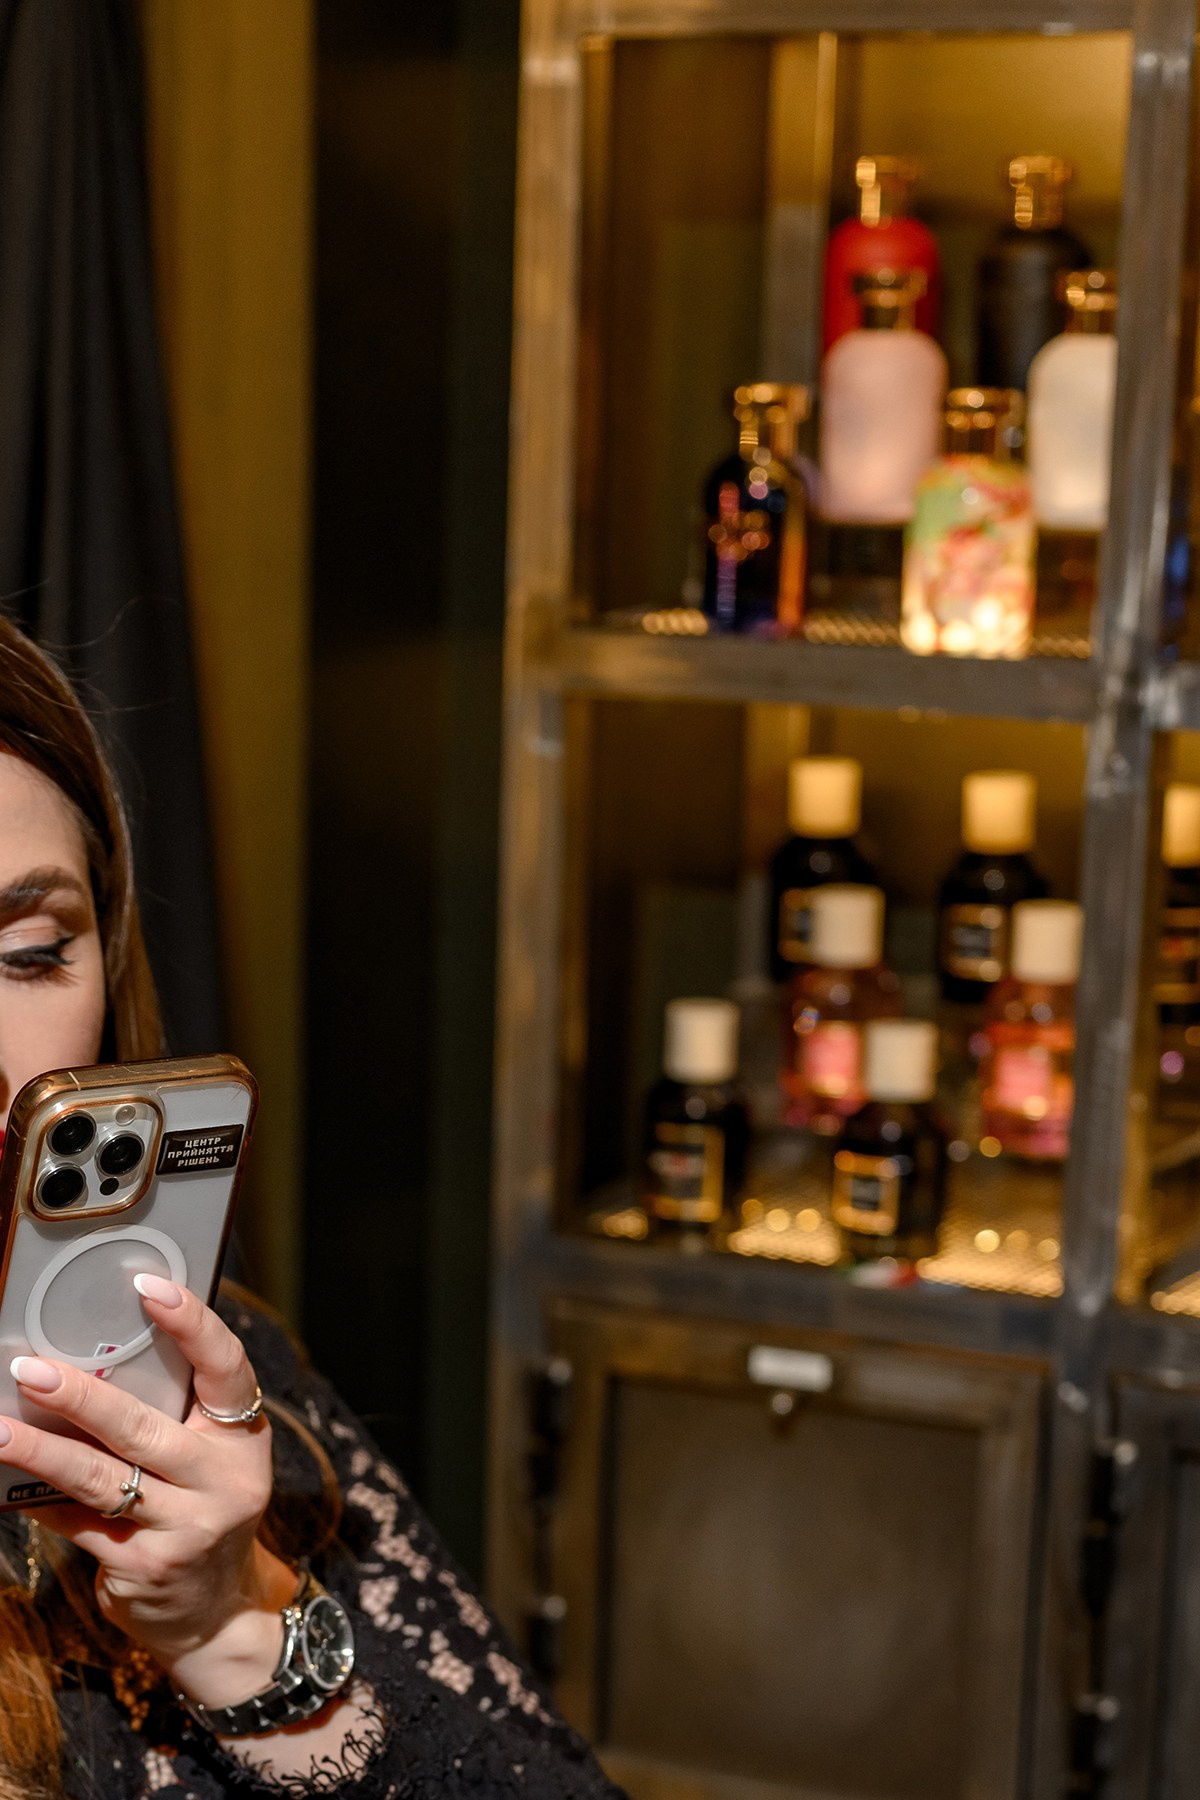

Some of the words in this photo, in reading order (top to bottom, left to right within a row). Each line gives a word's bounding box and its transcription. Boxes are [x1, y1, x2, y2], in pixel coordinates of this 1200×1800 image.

[184, 1137, 221, 1148] ЦЕНТР
[167, 1144, 234, 1159] ПРИЙНЯТТЯ
[177, 1155, 220, 1167] РІШЕНЬ
[11, 1488, 31, 1499] НЕ
